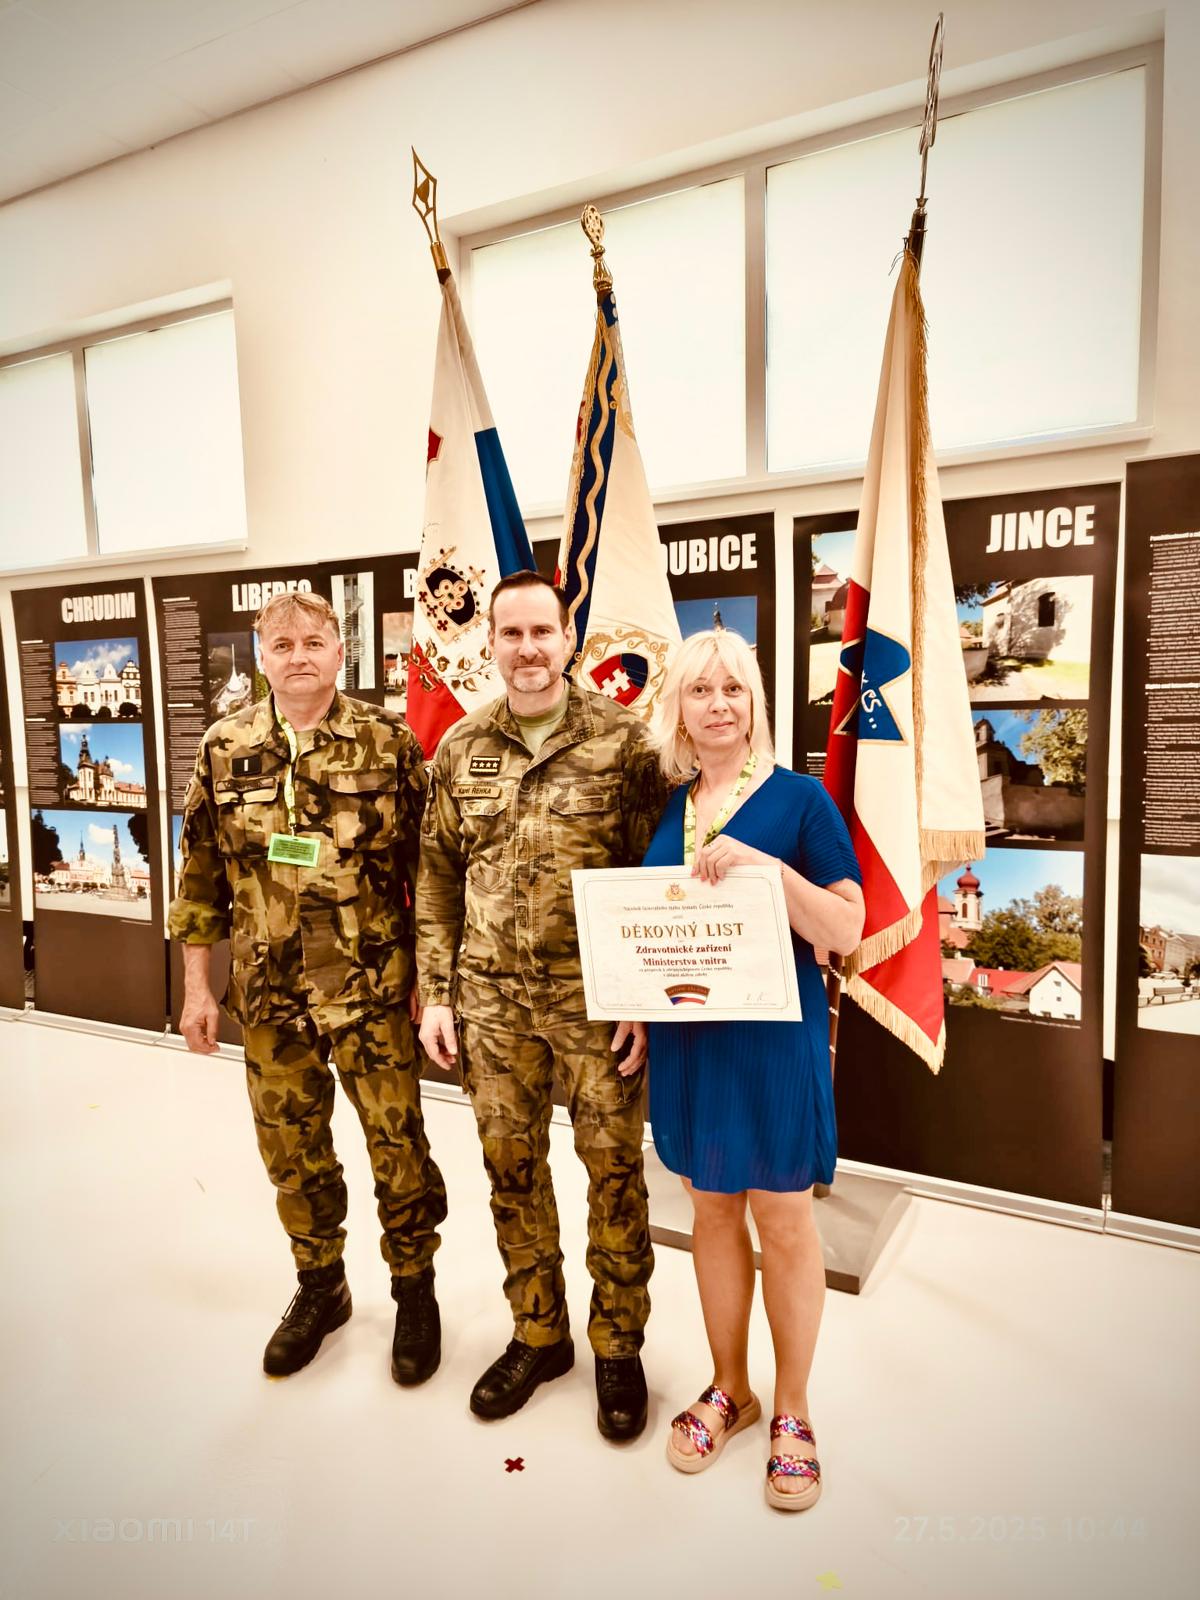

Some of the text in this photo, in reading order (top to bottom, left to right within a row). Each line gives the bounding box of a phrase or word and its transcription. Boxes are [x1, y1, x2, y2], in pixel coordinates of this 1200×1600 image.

[985, 505, 1096, 554] JINCE
[61, 592, 136, 624] CHRUDIM
[621, 921, 744, 938] DĚKOVNÝ LIST
[635, 943, 732, 954] Zdravotnické zařízení
[642, 957, 728, 967] Ministerstva vnitra
